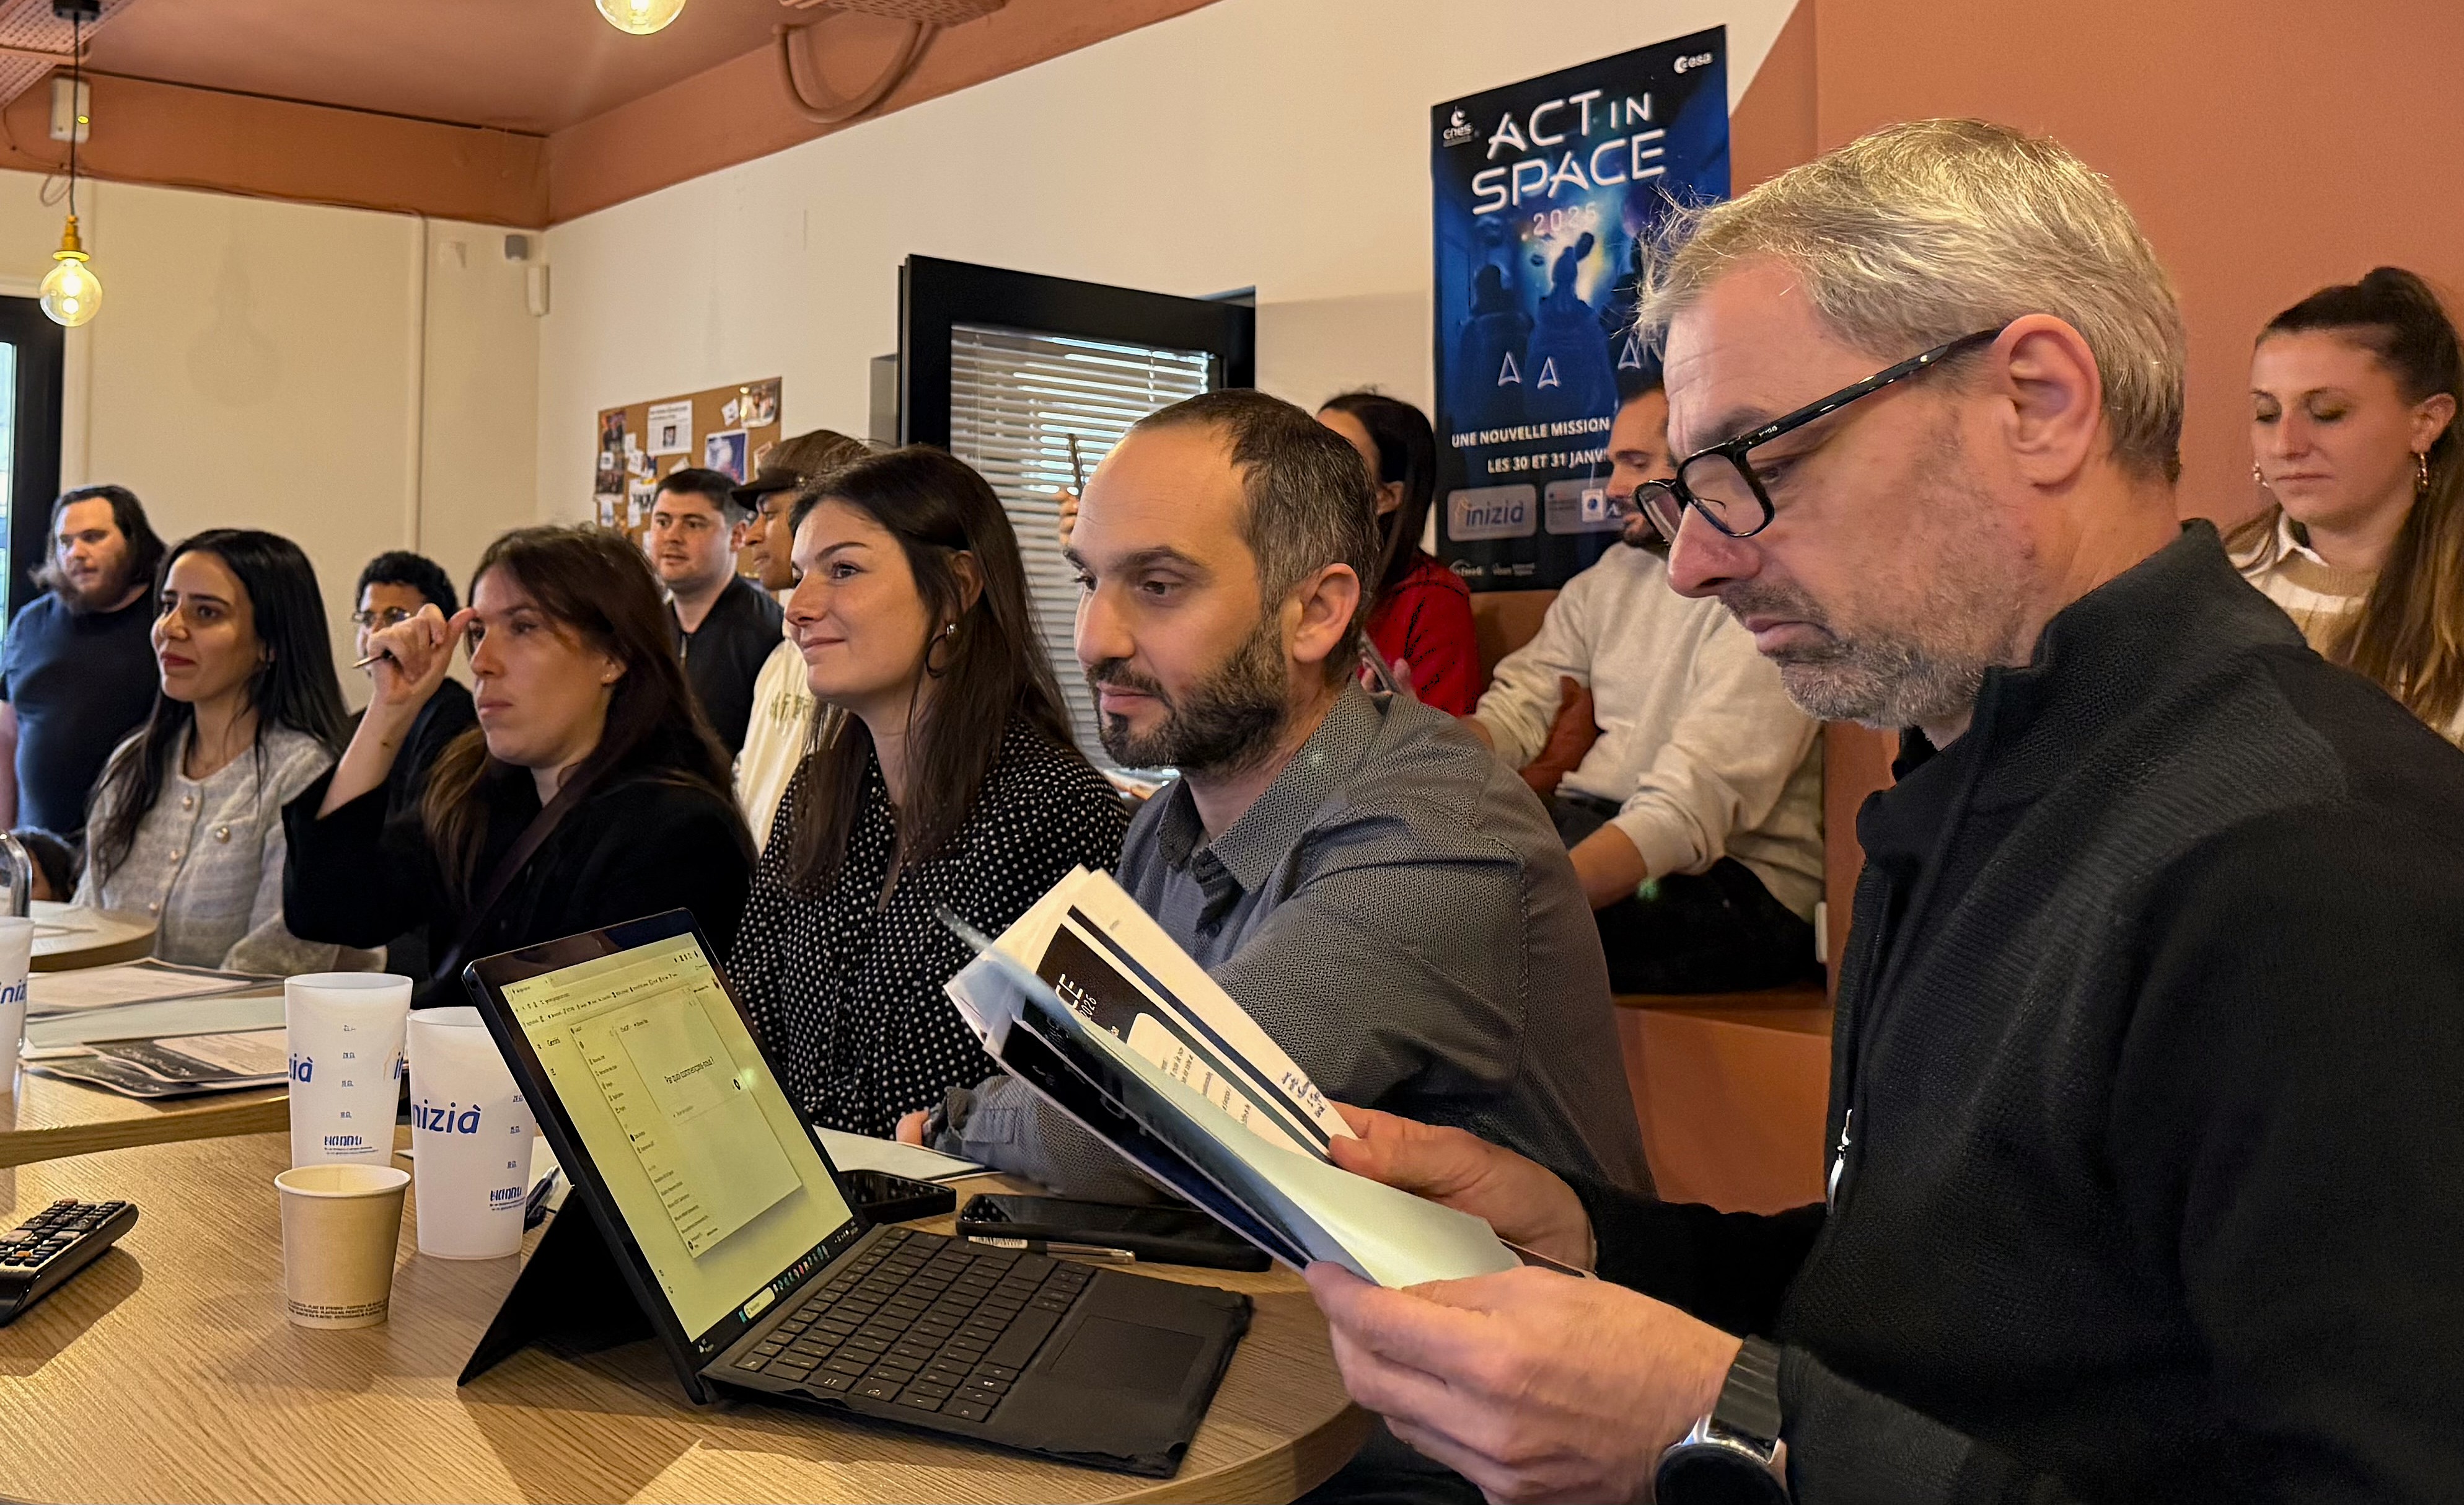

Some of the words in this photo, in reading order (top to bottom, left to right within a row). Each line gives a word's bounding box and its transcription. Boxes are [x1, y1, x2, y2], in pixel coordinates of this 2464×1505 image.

[1443, 122, 1473, 139] cnes
[1487, 89, 1603, 159] ACT
[1610, 91, 1652, 129] IN
[1471, 128, 1666, 215] SPACE
[1451, 431, 1478, 448] UNE
[1479, 423, 1548, 445] NOUVELLE
[1551, 417, 1611, 437] MISSION
[1487, 457, 1511, 474] LES
[1512, 455, 1530, 471] 30
[1531, 453, 1548, 469] ET
[1551, 452, 1567, 468] 31
